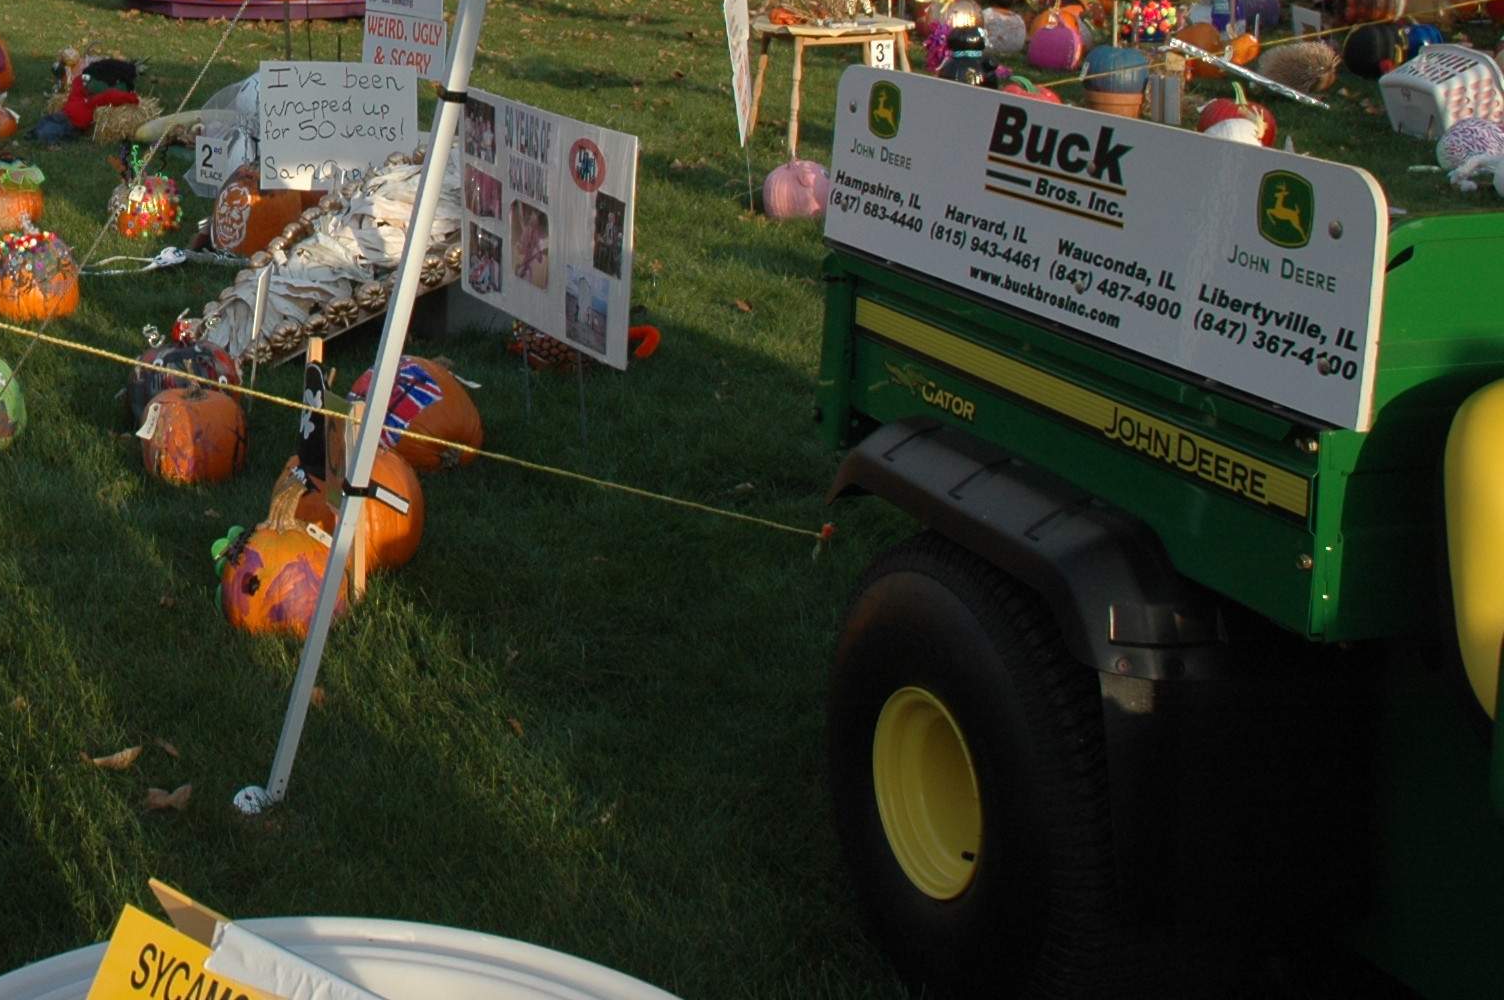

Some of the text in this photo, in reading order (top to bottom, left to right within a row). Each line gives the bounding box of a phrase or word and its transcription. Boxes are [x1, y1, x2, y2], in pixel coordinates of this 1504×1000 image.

[412, 21, 442, 46] UGLY
[268, 67, 405, 91] I've been
[374, 46, 432, 75] & SCARY
[264, 95, 390, 120] wrapped up
[265, 117, 405, 142] for 50 years!
[988, 103, 1132, 187] Buck
[850, 138, 912, 170] JOHN DEERE
[834, 170, 921, 210] Hampshire, IL
[1035, 178, 1124, 218] Bros. Inc.
[863, 202, 923, 233] 683-4440
[945, 204, 1028, 244] Harvard, IL
[930, 221, 1041, 272] (815) 943-4461
[1057, 238, 1177, 291] Wauconda, IL
[1228, 244, 1337, 293] JOHN DEERE
[969, 265, 1120, 329] www.buckbrosinc.com
[1050, 260, 1181, 320] (847) 487-4900
[1198, 284, 1358, 352] Libertyville, IL
[1194, 308, 1357, 381] (847) 367-400
[921, 381, 976, 422] GATOR
[1104, 405, 1269, 502] JOHN DEERE
[130, 942, 250, 1000] SYCA
